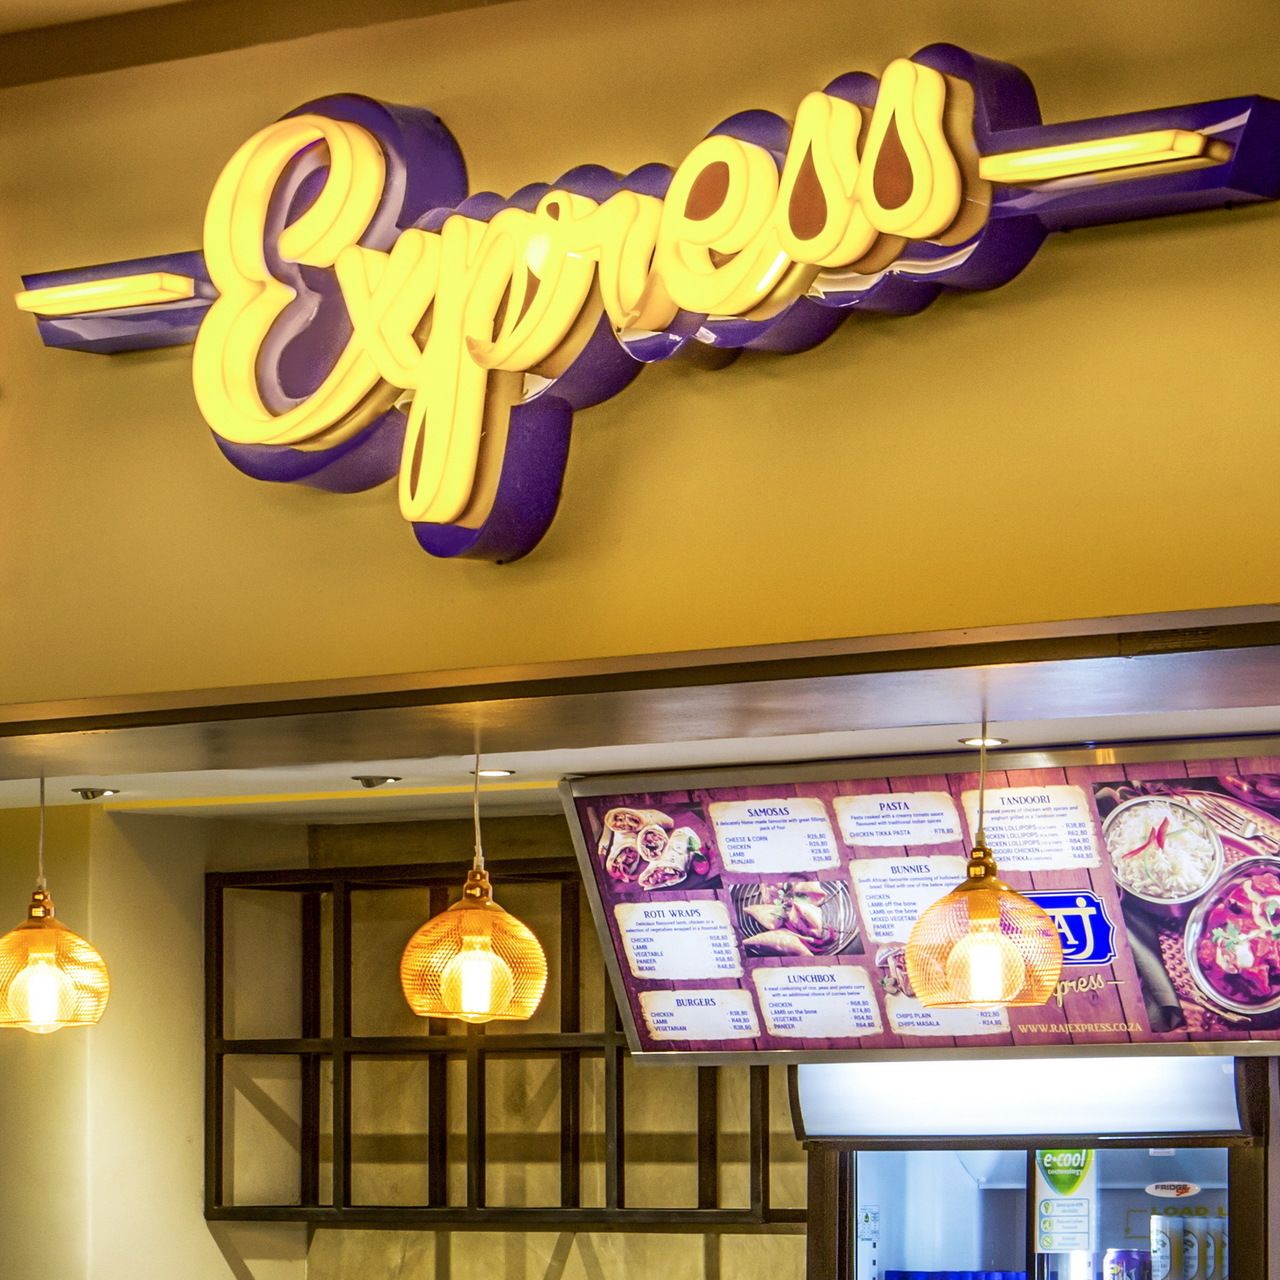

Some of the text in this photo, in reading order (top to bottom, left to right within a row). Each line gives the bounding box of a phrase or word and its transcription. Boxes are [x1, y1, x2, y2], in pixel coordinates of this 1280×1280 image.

[192, 57, 982, 526] Express
[1000, 795, 1050, 805] TANDOORI
[880, 802, 909, 811] PASTA
[747, 807, 789, 817] SAMOSAS
[891, 865, 930, 874] BUNNIES
[644, 909, 701, 919] ROTI WRAPS
[788, 974, 836, 983] LUNCHBOX
[1052, 973, 1105, 1007] press
[676, 998, 716, 1007] BURGERS
[913, 1011, 931, 1019] PLAIN
[915, 1019, 940, 1027] MASALA
[1019, 1023, 1142, 1034] WWW.RAJEXPRESS.CO.ZA
[1048, 1168, 1082, 1176] technology
